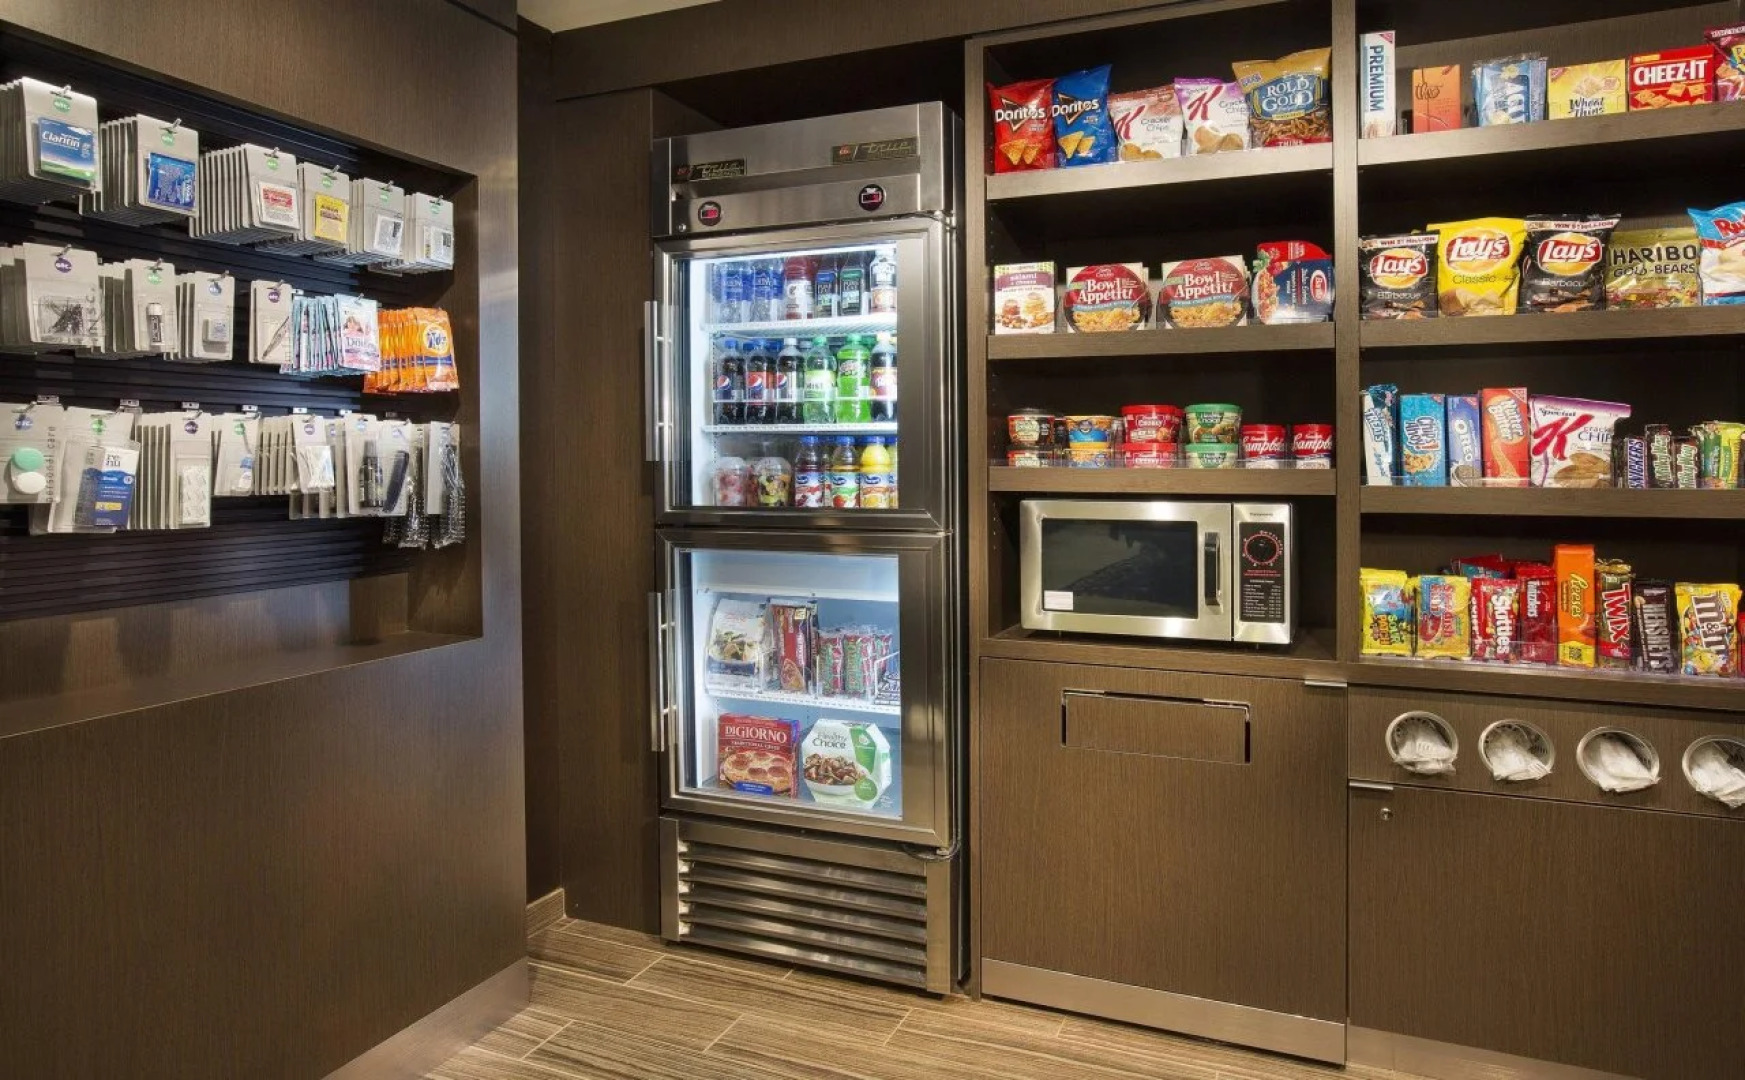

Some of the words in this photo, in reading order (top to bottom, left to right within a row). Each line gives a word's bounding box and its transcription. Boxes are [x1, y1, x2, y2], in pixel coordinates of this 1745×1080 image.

[1368, 44, 1385, 112] PREMIUM
[1633, 60, 1708, 86] CHEEZ-IT
[1267, 78, 1310, 97] ROLD
[1052, 98, 1100, 117] Doritos
[1187, 85, 1224, 121] K
[1261, 90, 1314, 111] GOLD
[1569, 97, 1604, 110] Wheat
[995, 104, 1046, 122] Doritos
[1114, 105, 1146, 139] K
[1541, 240, 1599, 263] Lay's
[1612, 244, 1697, 265] HARIBO
[1085, 278, 1121, 292] Bowl
[1183, 270, 1221, 286] Bowl
[1452, 273, 1496, 285] Classic
[1365, 408, 1385, 442] TREATS
[1531, 413, 1595, 461] K
[1491, 594, 1513, 654] Skittles
[1602, 583, 1631, 643] TWIX
[1379, 614, 1392, 645] PATCH
[812, 737, 846, 749] Choice
